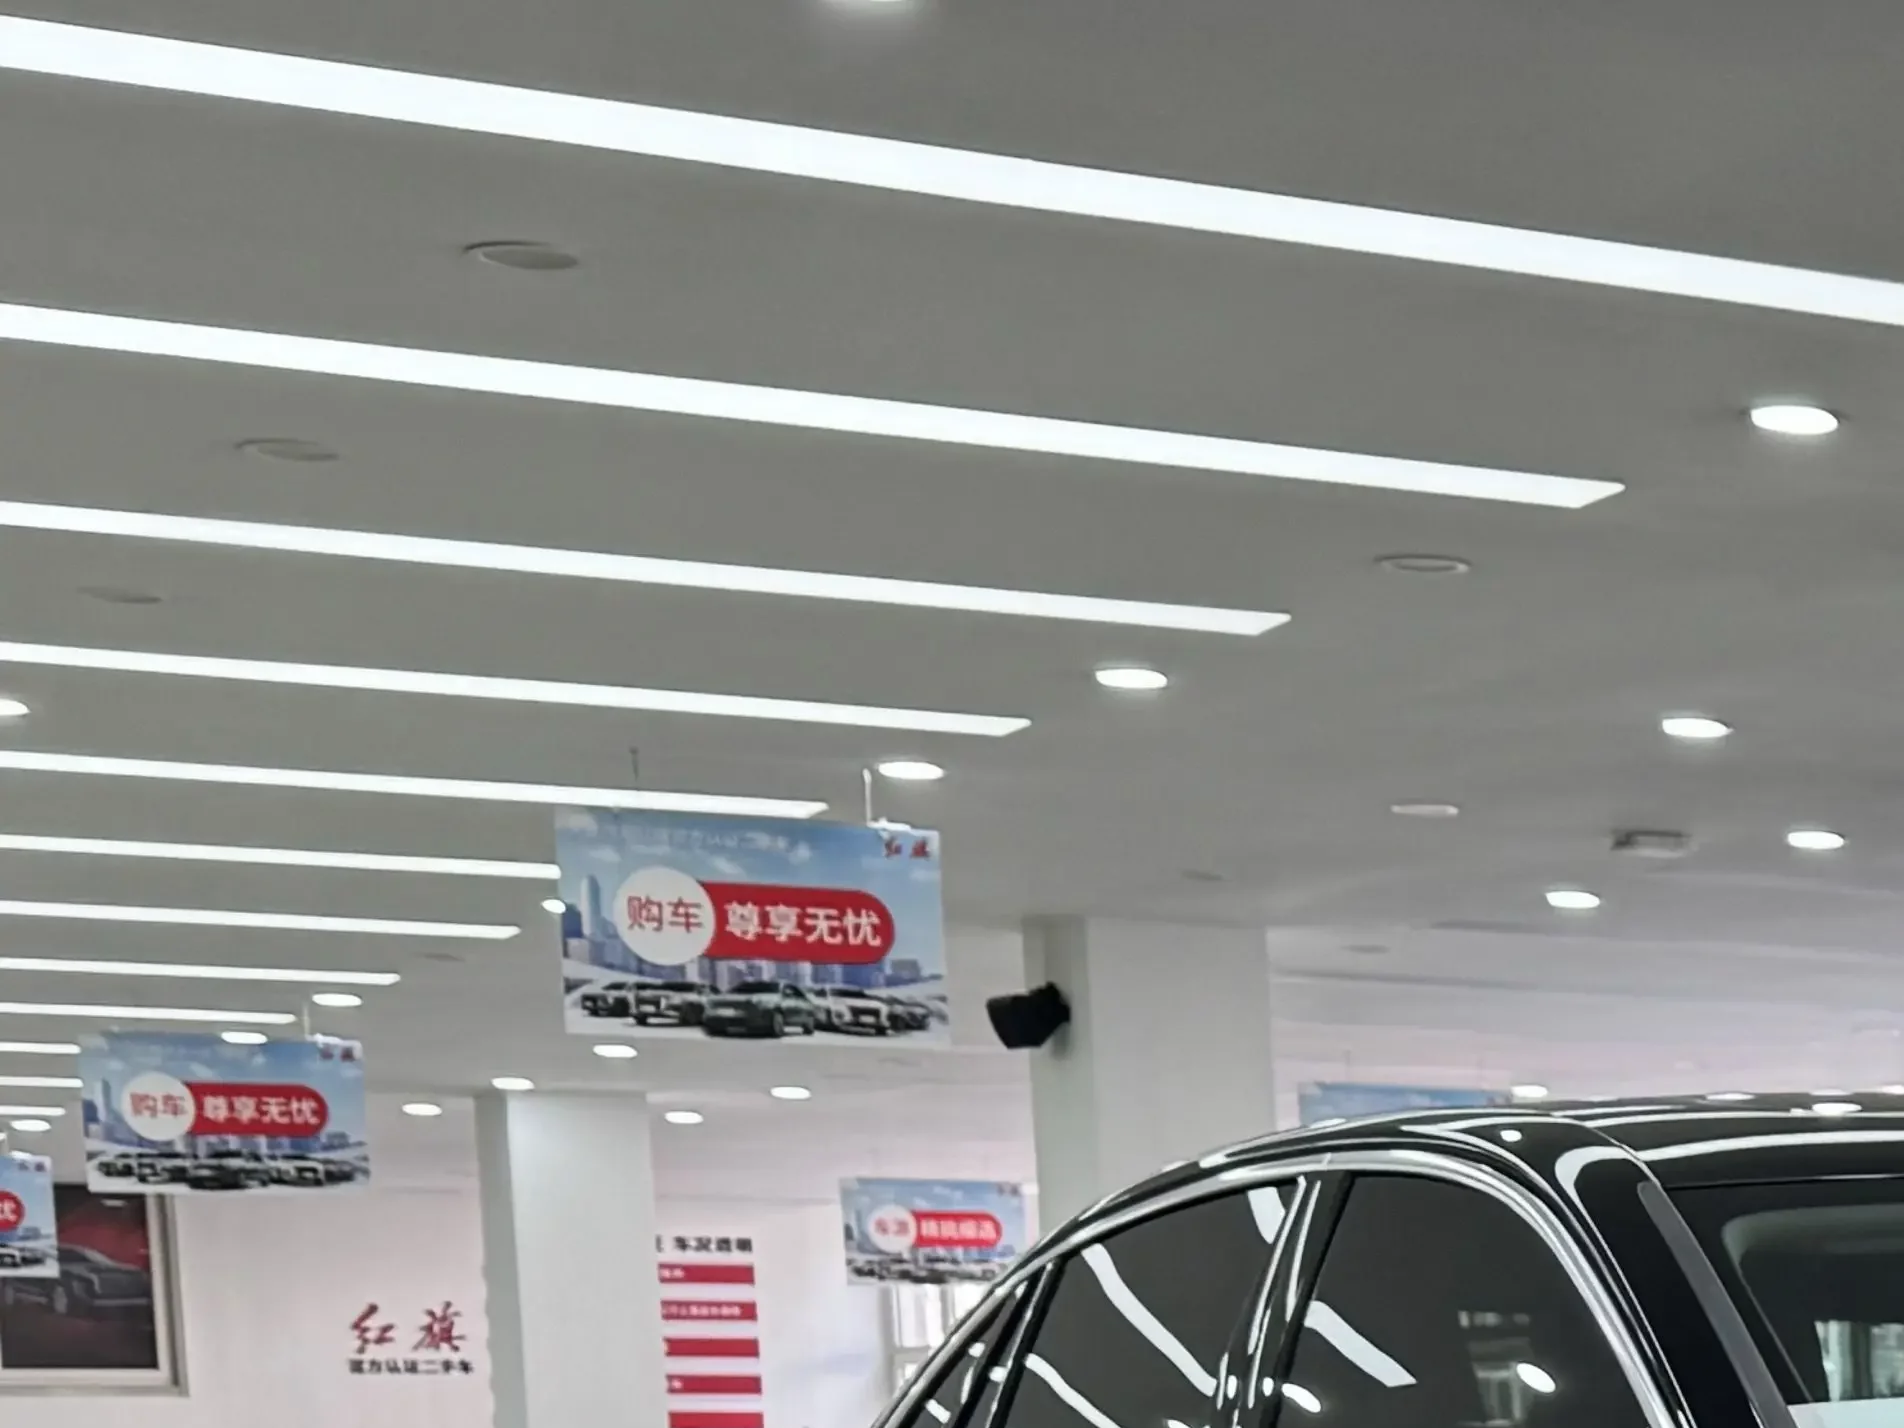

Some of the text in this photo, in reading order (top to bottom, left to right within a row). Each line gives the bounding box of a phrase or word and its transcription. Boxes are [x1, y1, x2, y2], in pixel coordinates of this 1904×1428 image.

[627, 894, 884, 947] 购车 尊享无忧
[350, 1300, 467, 1354] 红旗
